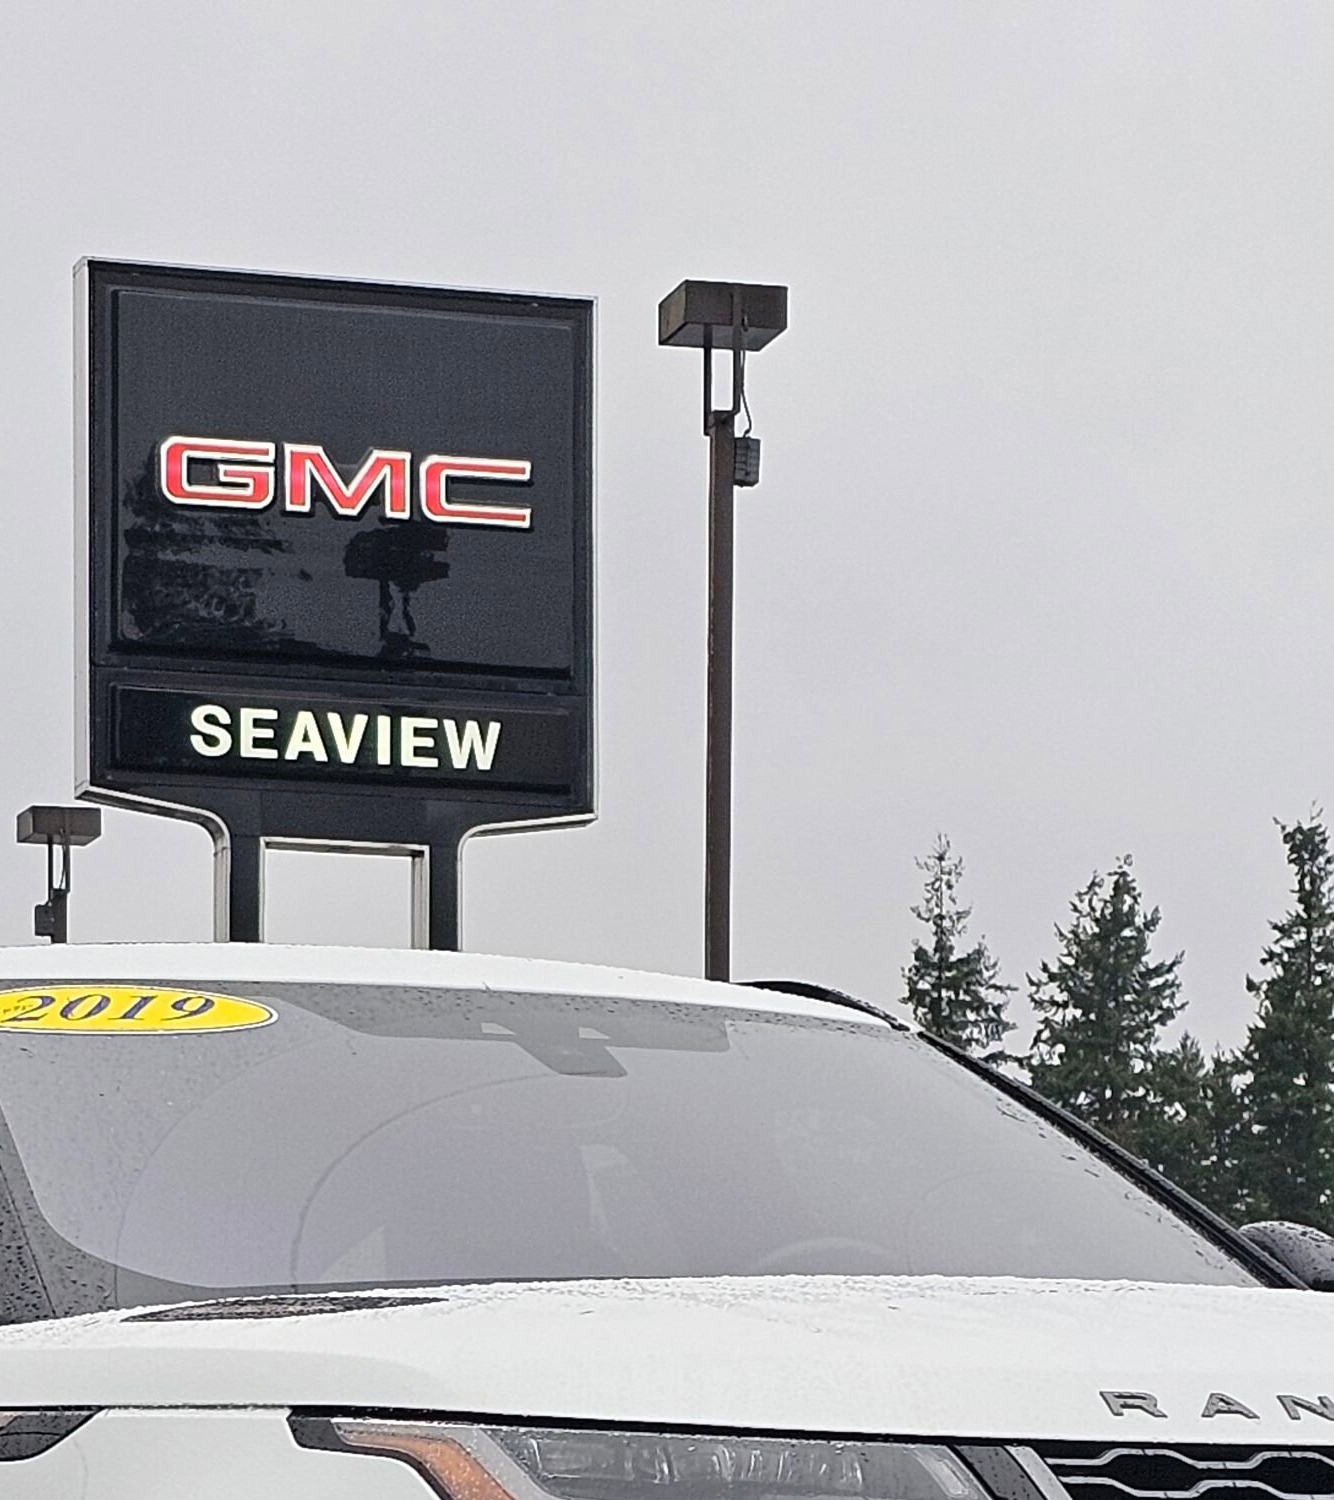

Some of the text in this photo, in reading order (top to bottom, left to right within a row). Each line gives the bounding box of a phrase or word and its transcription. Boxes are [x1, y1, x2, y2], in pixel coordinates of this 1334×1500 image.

[160, 436, 532, 529] GMC
[189, 704, 502, 771] SEAVIEW
[0, 993, 215, 1023] 2019
